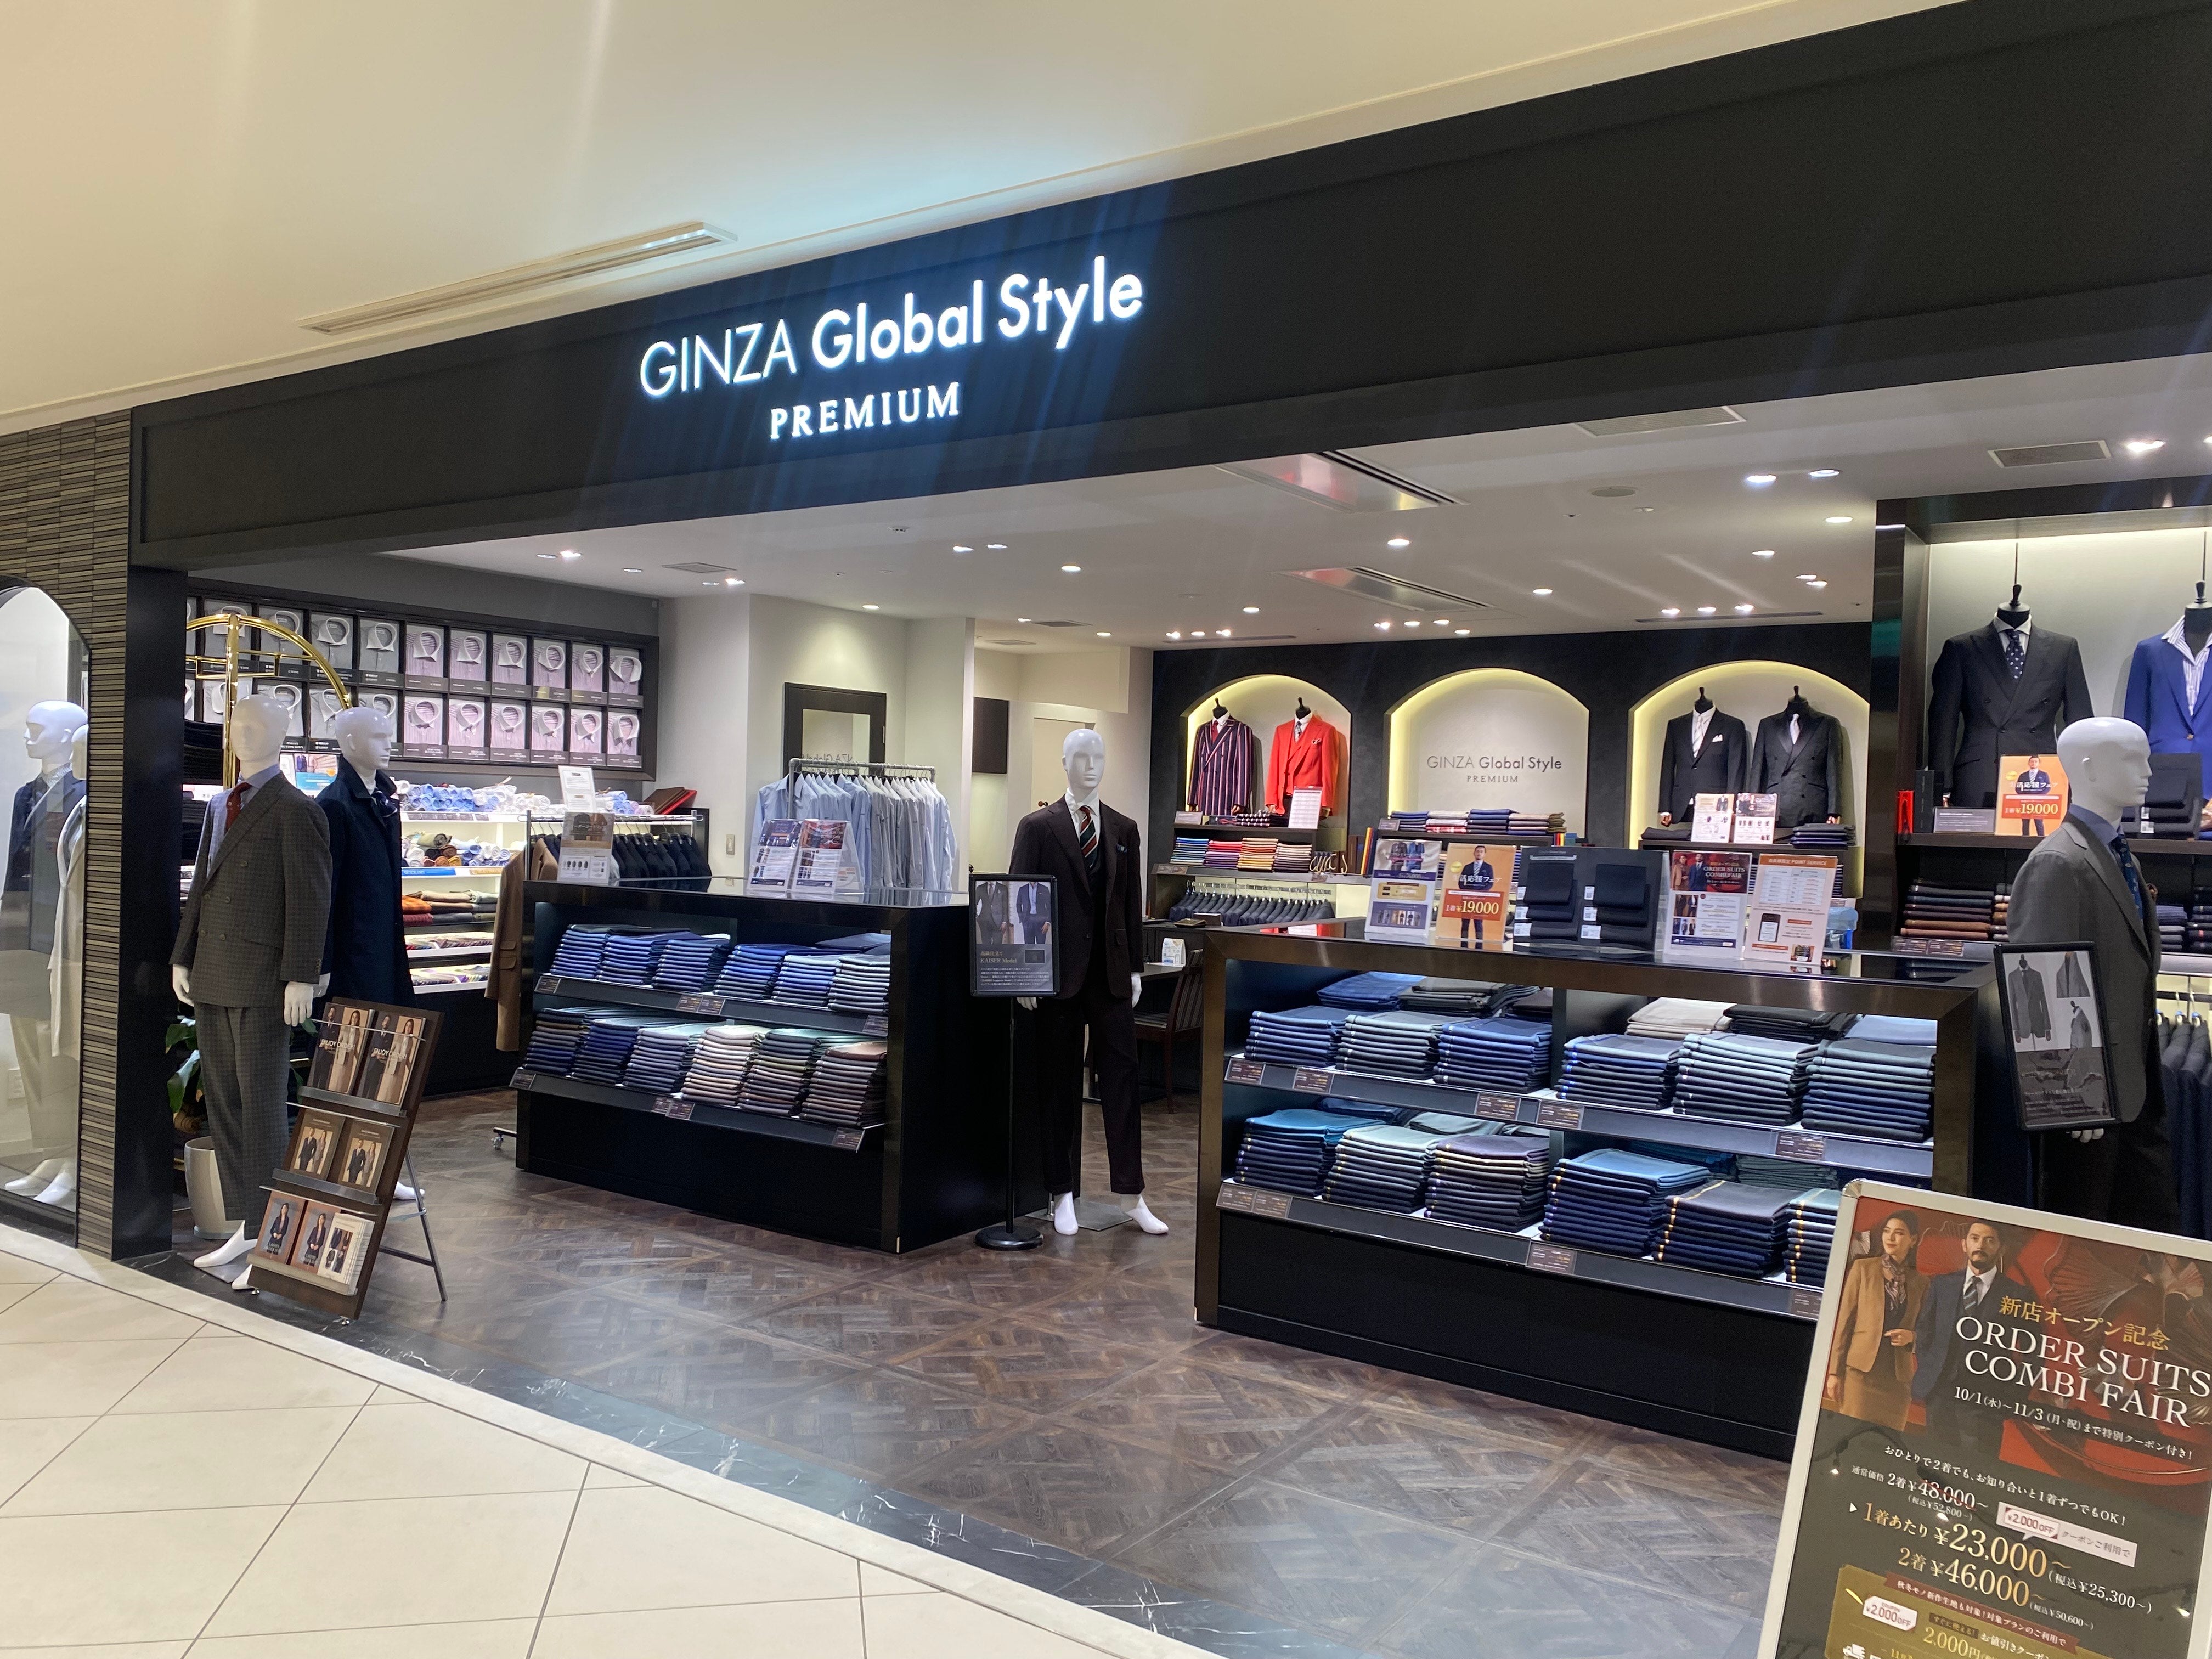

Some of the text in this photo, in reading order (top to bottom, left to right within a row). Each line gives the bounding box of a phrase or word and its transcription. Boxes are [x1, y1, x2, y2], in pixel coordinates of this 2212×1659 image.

[640, 255, 1144, 398] GINZA Global Style
[769, 381, 961, 441] PREMIUM
[1427, 755, 1562, 772] GINZA Global Style
[321, 1038, 356, 1050] ENJOY ORDER!
[373, 1047, 390, 1057] ENJOY
[1999, 1295, 2171, 1351] 新店オープン記念
[1956, 1316, 2211, 1398] ORDER SUITS
[1965, 1350, 2191, 1429] COMBI FAIR
[1852, 1465, 1884, 1482] 通常価格
[1863, 1502, 1928, 1538] 1着あたり
[2062, 1531, 2131, 1558] クーポンご利用で
[1898, 1547, 1927, 1572] 2着
[1980, 1632, 2049, 1659] お値引きクーポ
